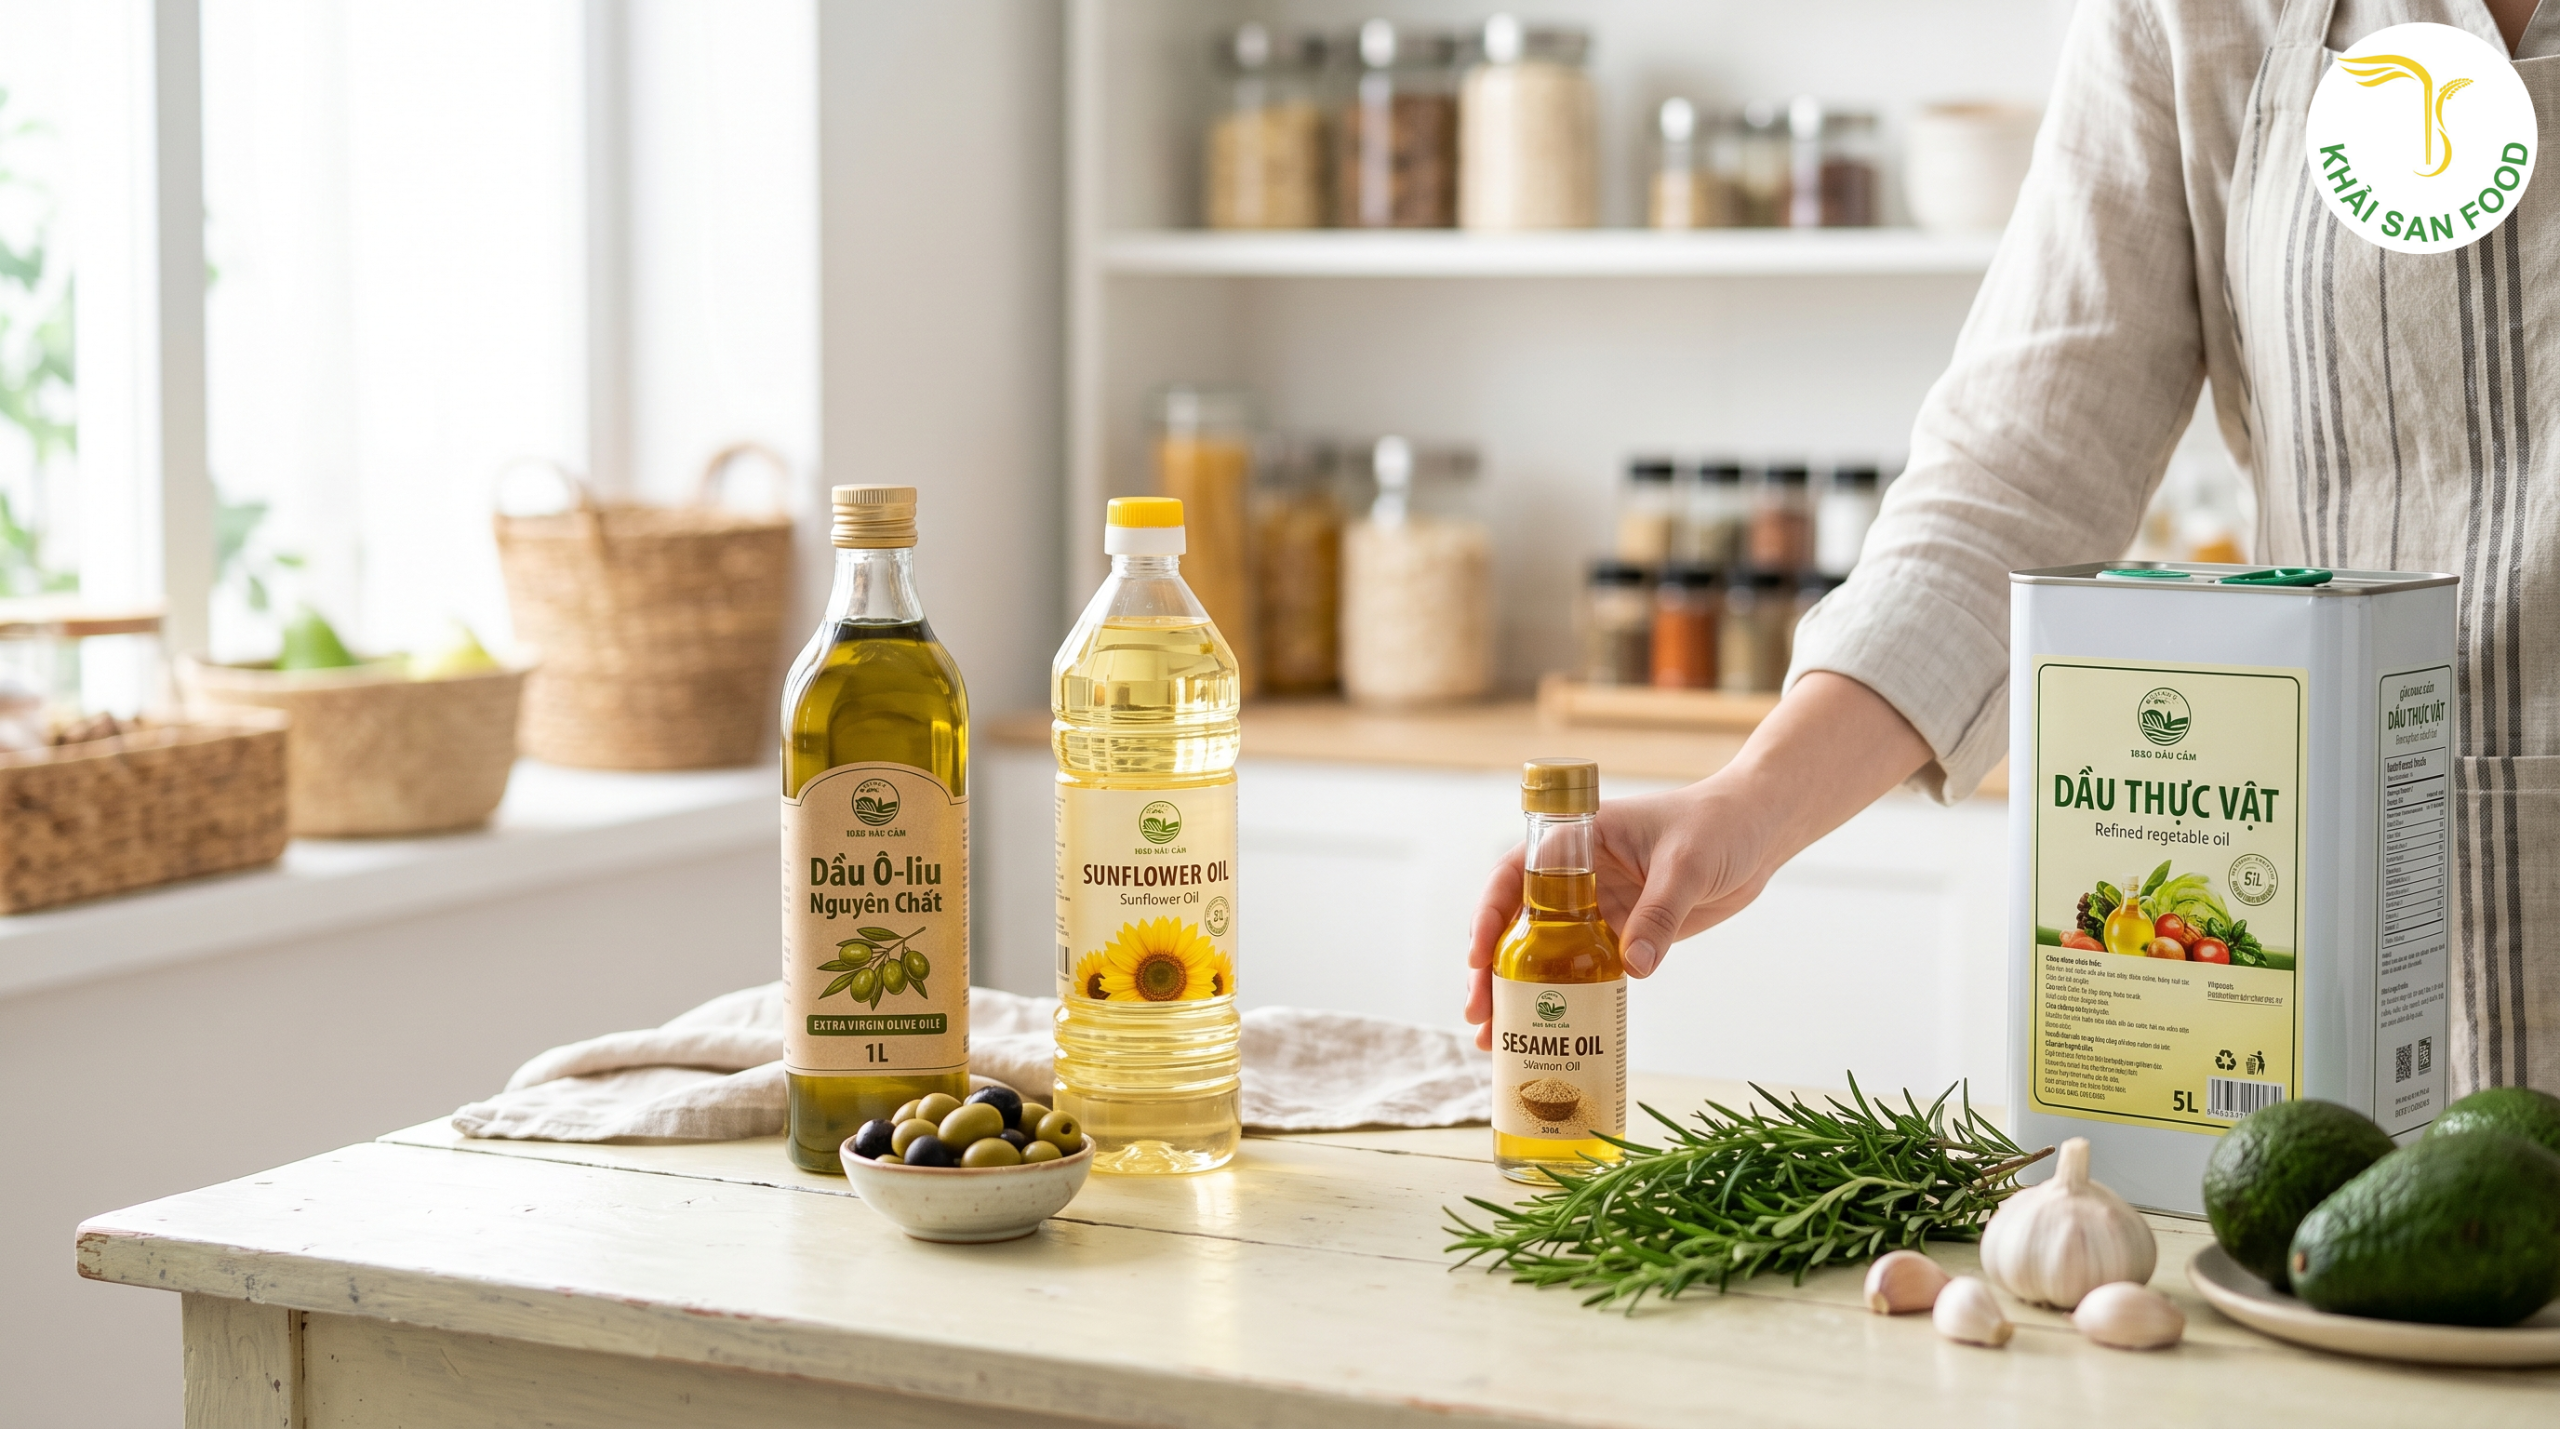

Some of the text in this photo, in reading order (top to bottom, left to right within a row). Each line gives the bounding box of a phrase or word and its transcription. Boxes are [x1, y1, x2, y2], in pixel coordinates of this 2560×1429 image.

[2054, 765, 2279, 831] DẦU THỰC VẬT
[2095, 822, 2230, 847] Refined regetable oil
[810, 850, 942, 887] Dầu Ô-liu
[1083, 859, 1229, 887] SUNFLOWER OIL
[810, 889, 942, 919] Nguyên Chất
[1120, 891, 1199, 906] Sunflower Oil
[813, 1018, 941, 1032] EXTRA VIRGIN OLIVE OILE
[864, 1043, 889, 1063] 1L
[1502, 1032, 1604, 1056] SESAME OIL
[2172, 1090, 2199, 1114] 5L
